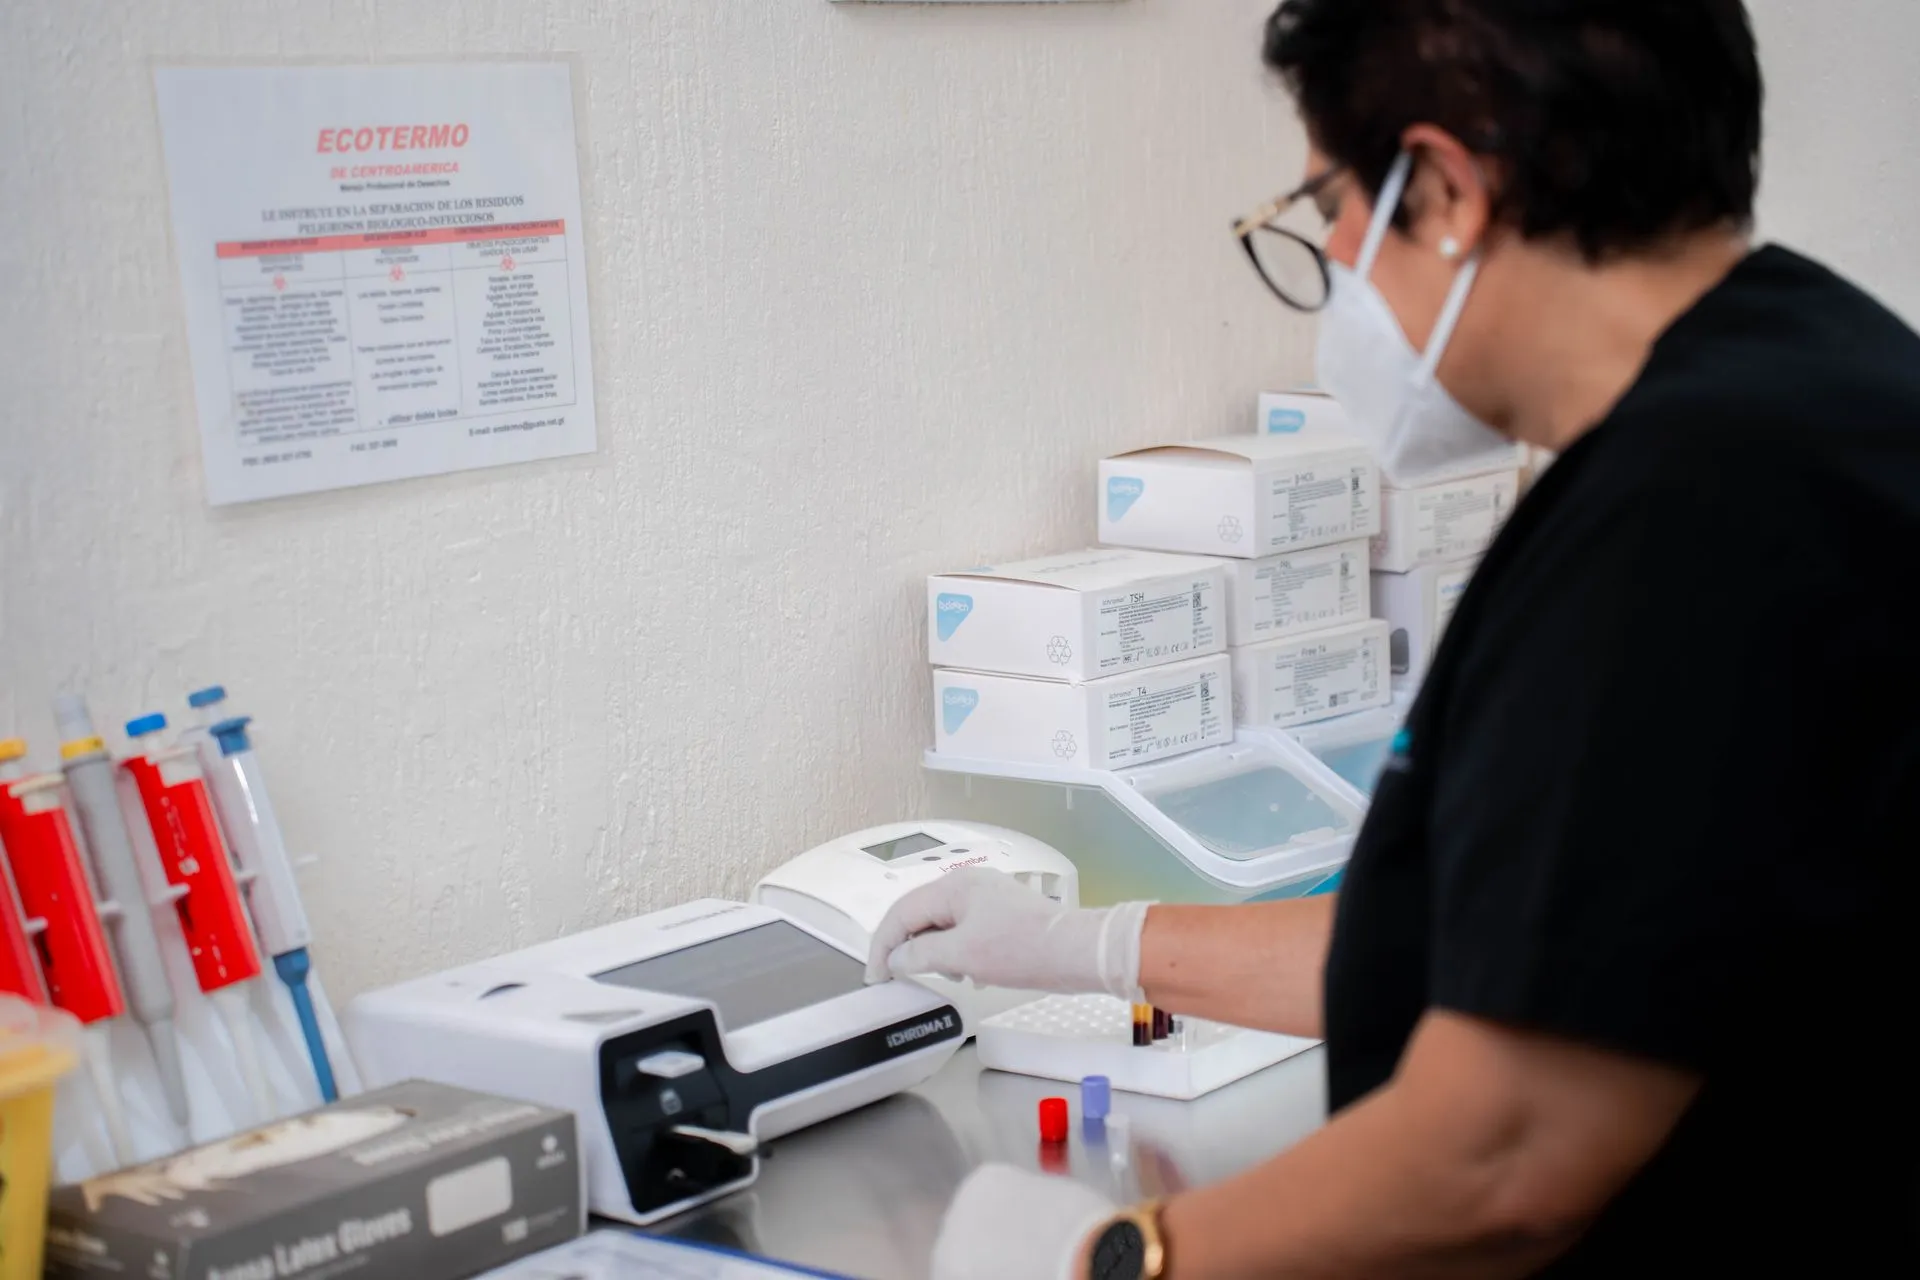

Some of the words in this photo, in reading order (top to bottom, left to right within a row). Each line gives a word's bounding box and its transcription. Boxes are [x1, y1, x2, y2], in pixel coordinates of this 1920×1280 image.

[316, 123, 470, 154] ECOTERMO
[330, 166, 348, 179] DE
[351, 162, 460, 178] CENTROAMERICA
[354, 204, 367, 217] LA
[368, 200, 435, 216] SEPARACION
[438, 199, 451, 212] DE
[454, 197, 473, 210] LOS
[475, 194, 525, 209] RESIDUOS
[298, 219, 364, 234] PELIGROSOS
[366, 211, 495, 231] BIOLOGICO-INFECCIOSOS
[1130, 591, 1145, 603] TSH
[1136, 686, 1147, 697] T4
[273, 1231, 338, 1277] Latex
[337, 1206, 413, 1254] Gloves
